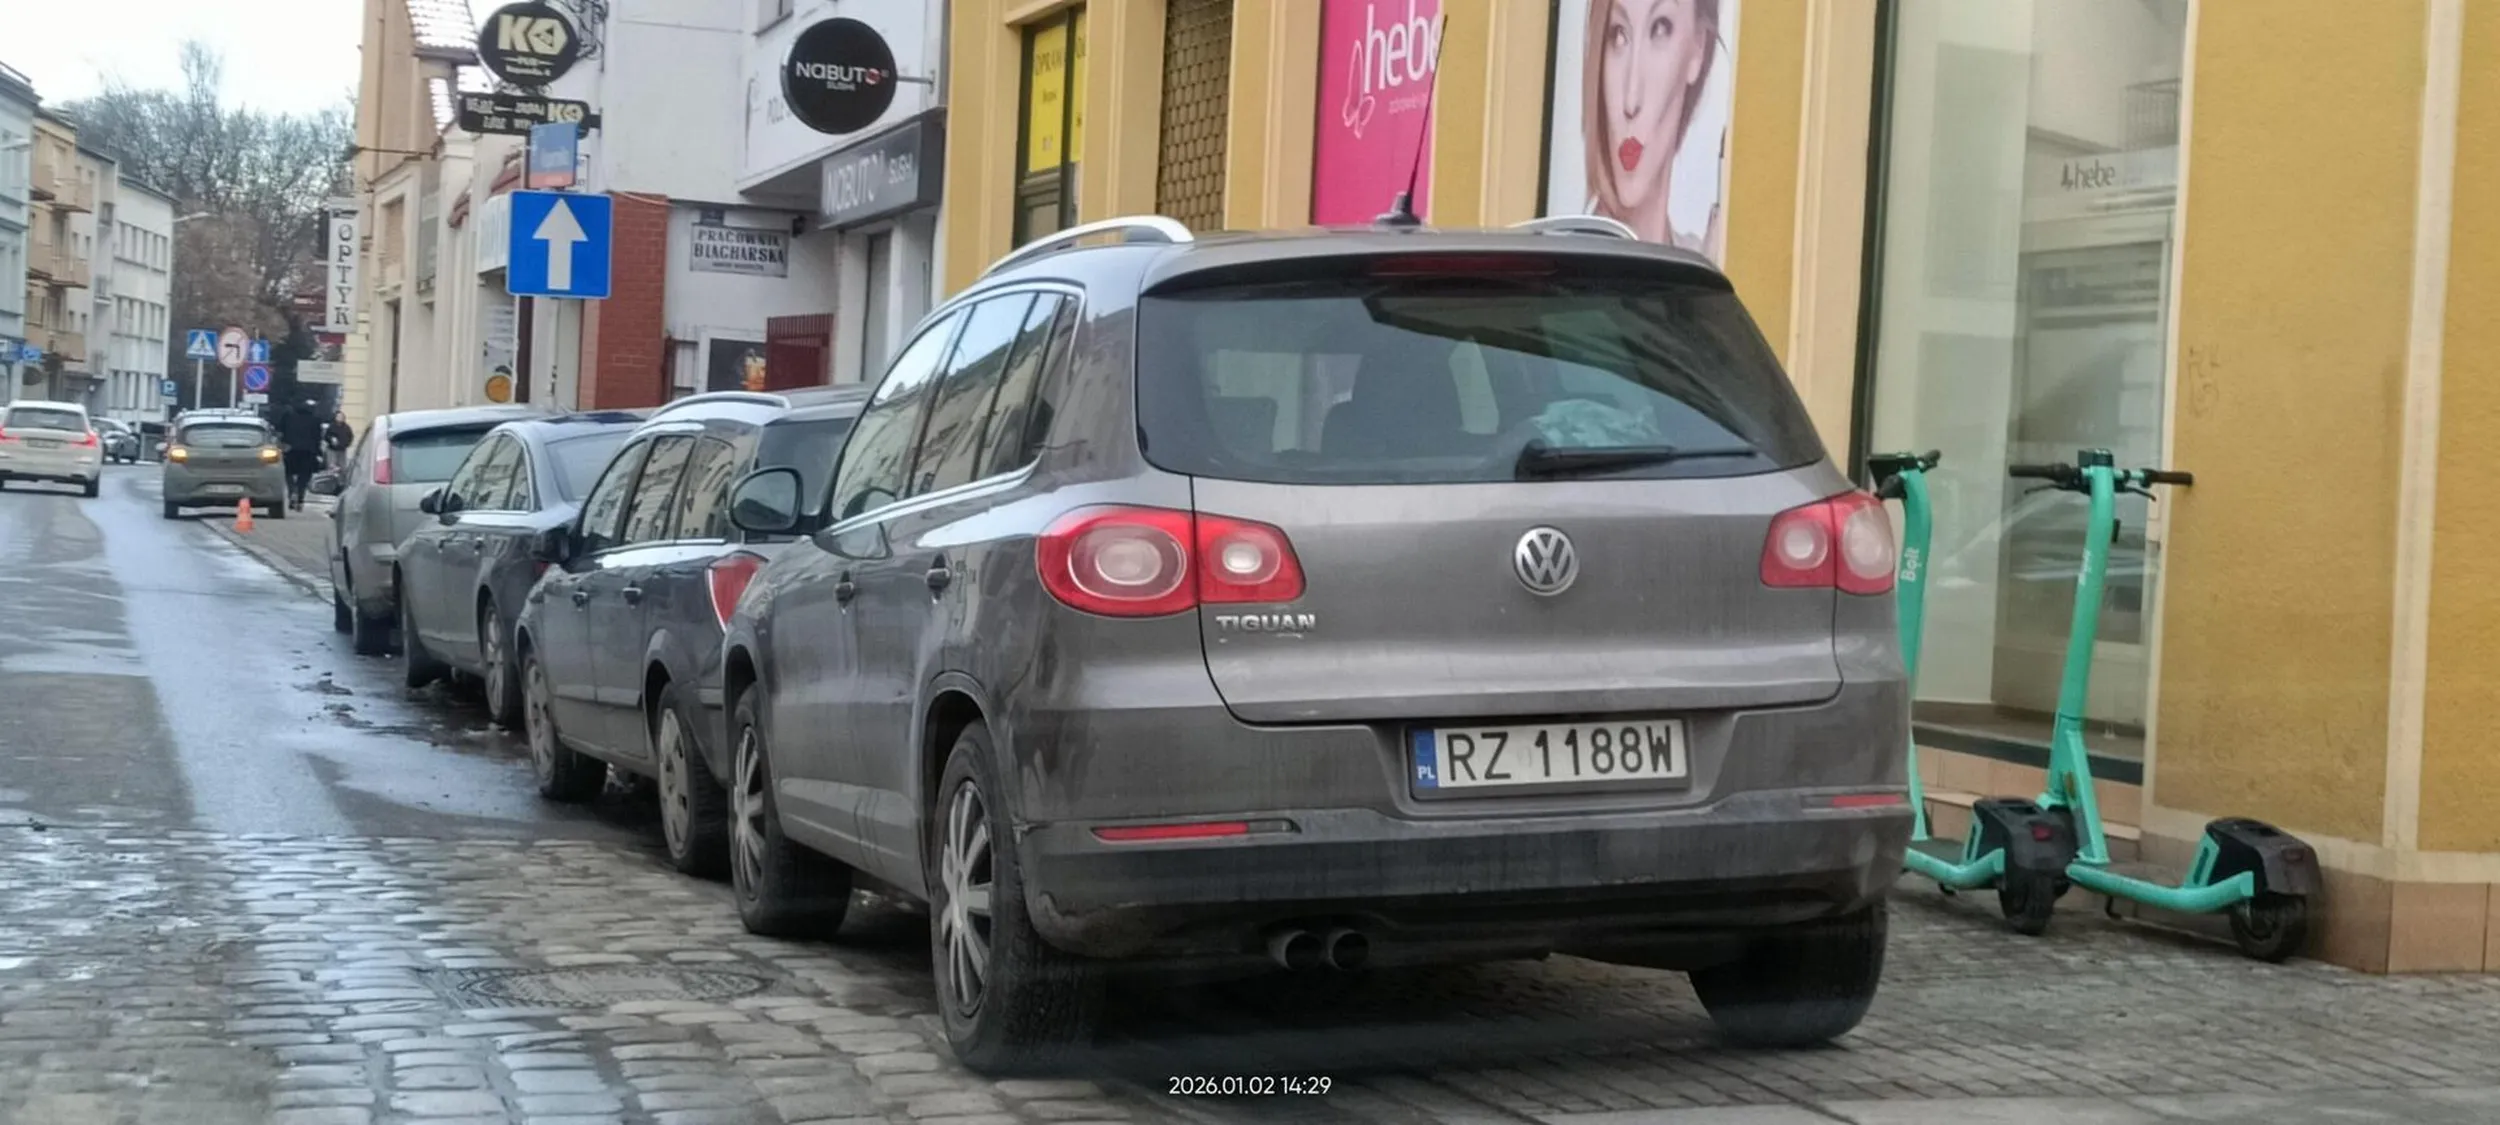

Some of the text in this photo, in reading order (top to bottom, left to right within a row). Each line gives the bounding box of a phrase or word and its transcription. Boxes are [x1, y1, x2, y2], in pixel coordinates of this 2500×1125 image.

[334, 223, 353, 325] OPTYK
[1900, 547, 1921, 582] Bolt
[1215, 612, 1316, 632] TIGUAN
[1446, 724, 1673, 782] RZ 1188W
[1417, 765, 1436, 780] PL
